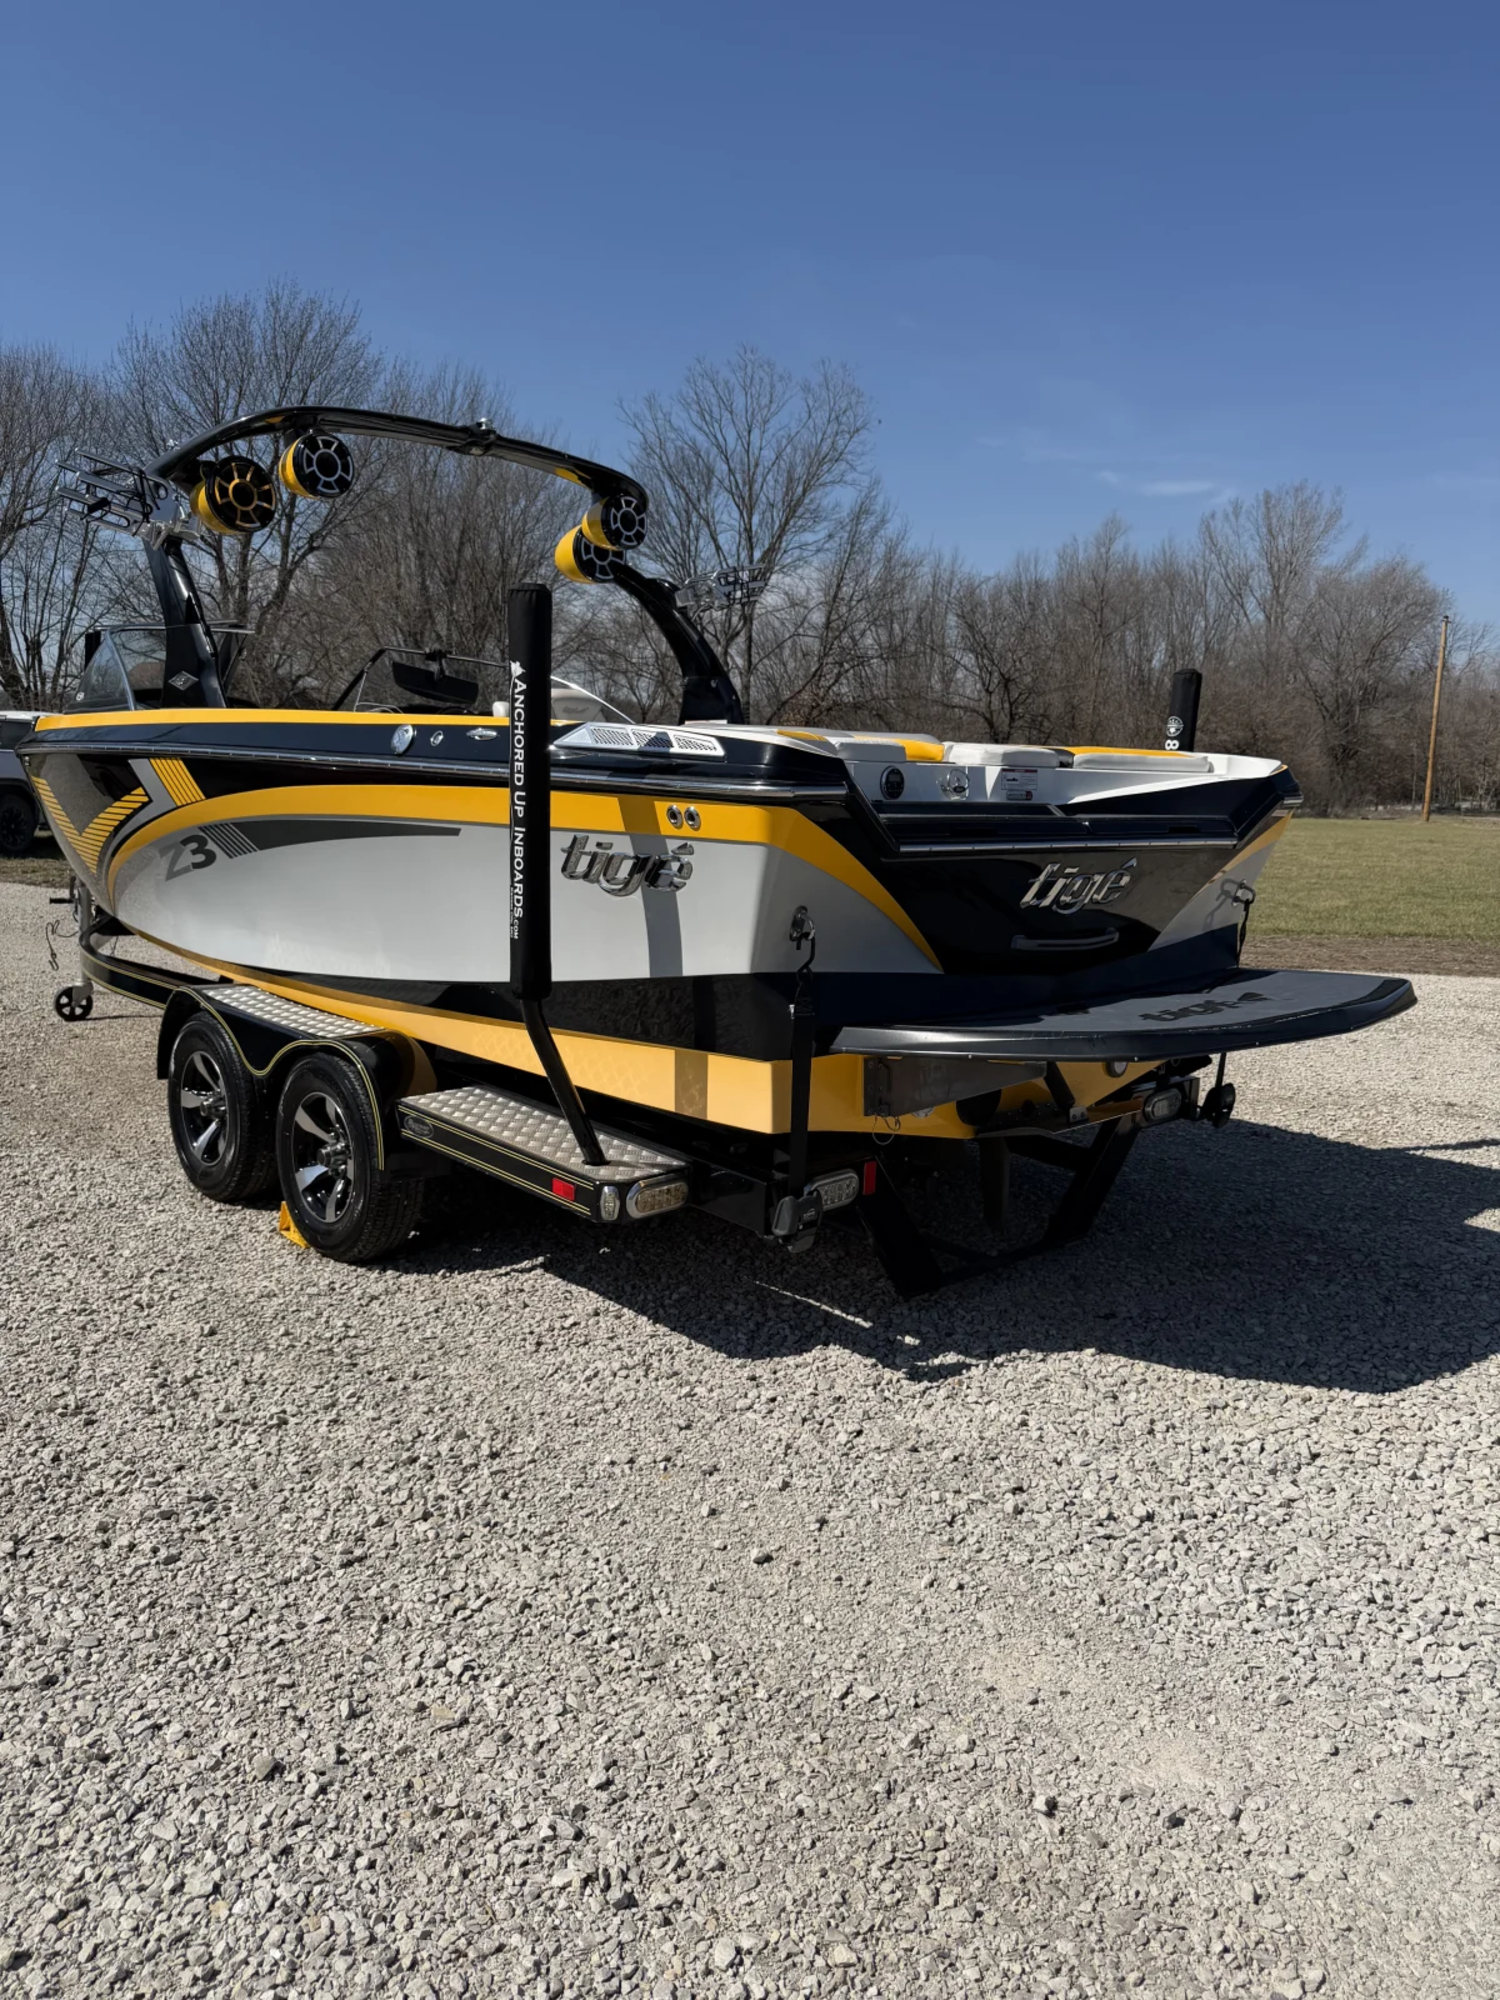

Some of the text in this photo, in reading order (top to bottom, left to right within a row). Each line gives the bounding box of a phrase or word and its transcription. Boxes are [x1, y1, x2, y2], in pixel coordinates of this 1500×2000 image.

[513, 678, 527, 939] ANCHORED UP INBOARDS.COM
[159, 834, 217, 882] Z3
[560, 834, 695, 897] tigé
[1019, 858, 1137, 914] tigé
